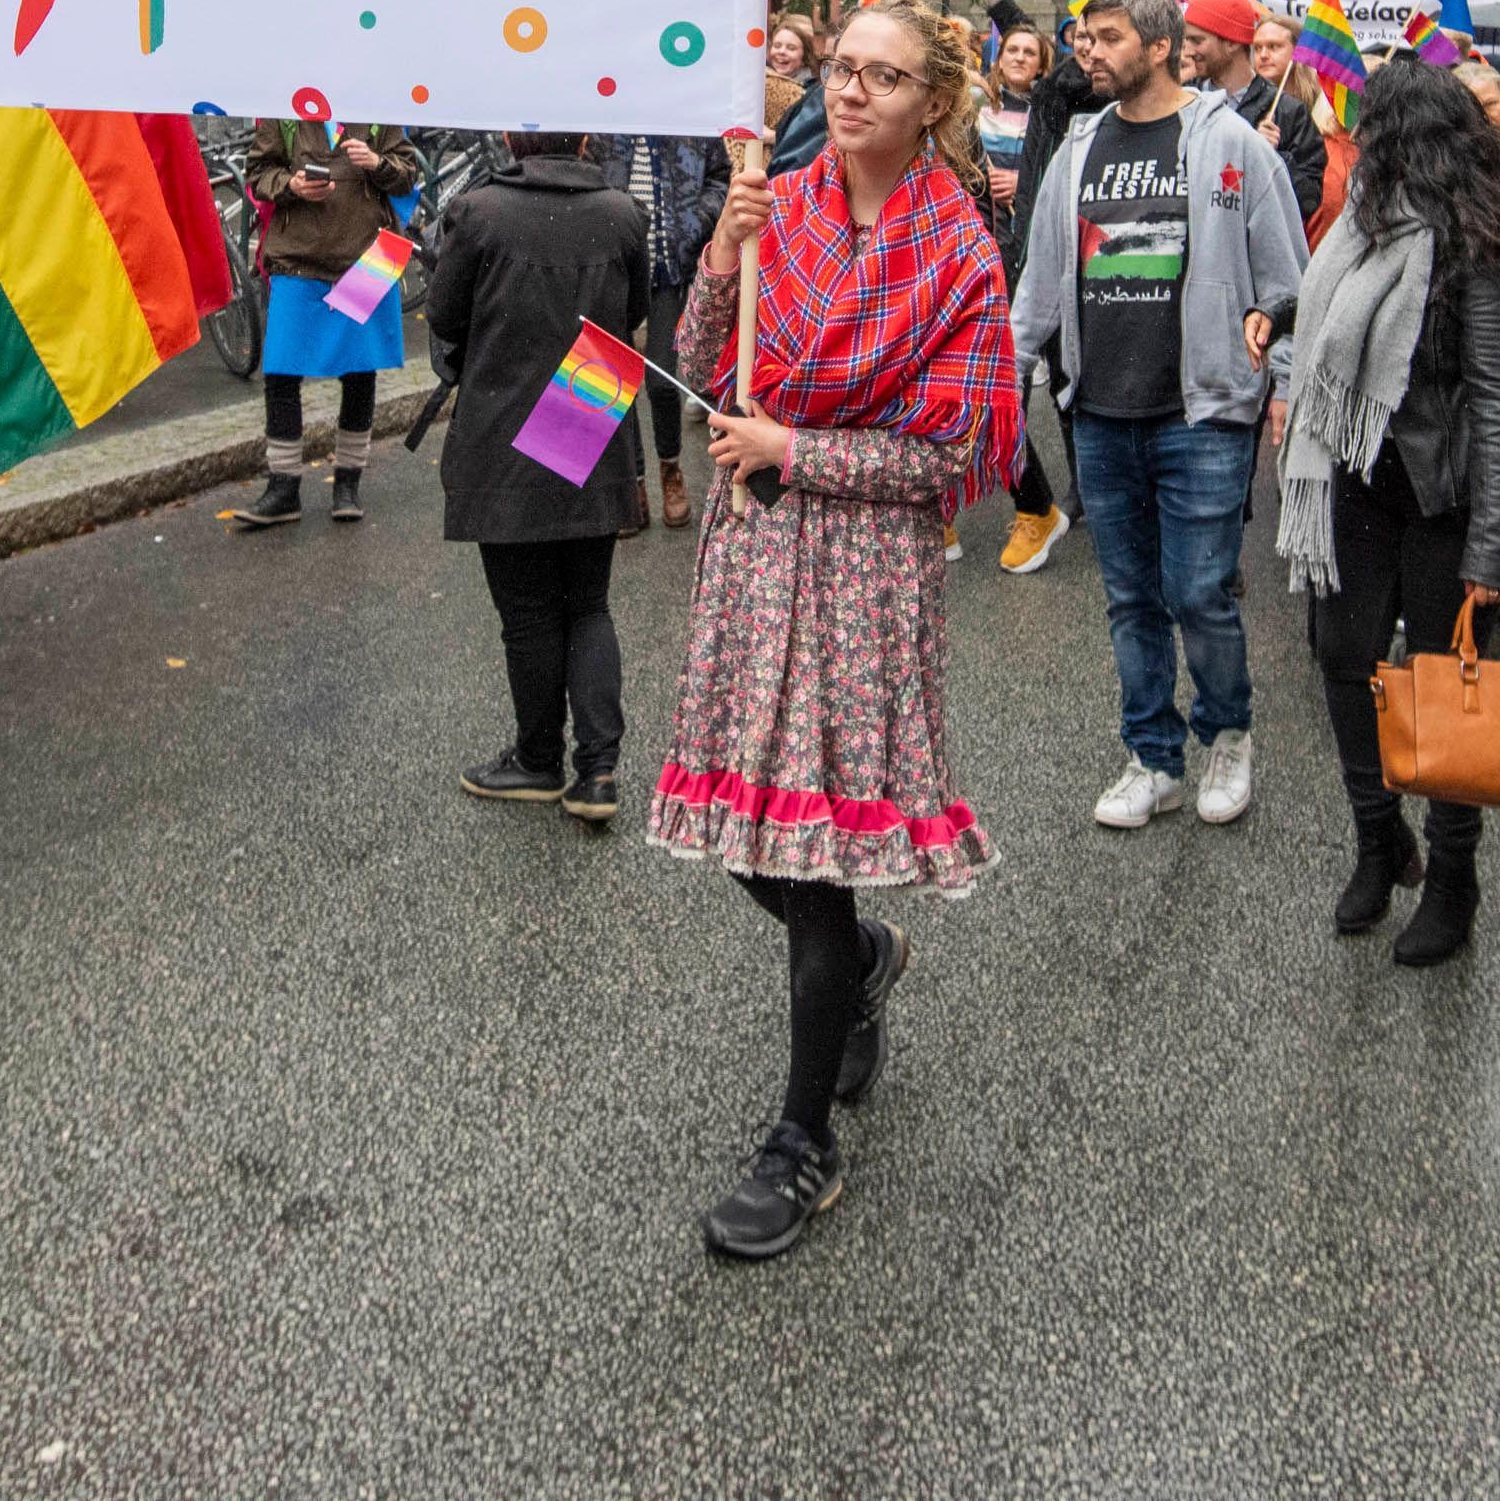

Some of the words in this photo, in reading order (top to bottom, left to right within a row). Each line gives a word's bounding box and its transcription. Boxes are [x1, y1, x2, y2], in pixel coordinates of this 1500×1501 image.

[1102, 159, 1158, 183] FREE
[1079, 176, 1189, 203] ALESTINE
[1098, 285, 1172, 306] فلسطين
